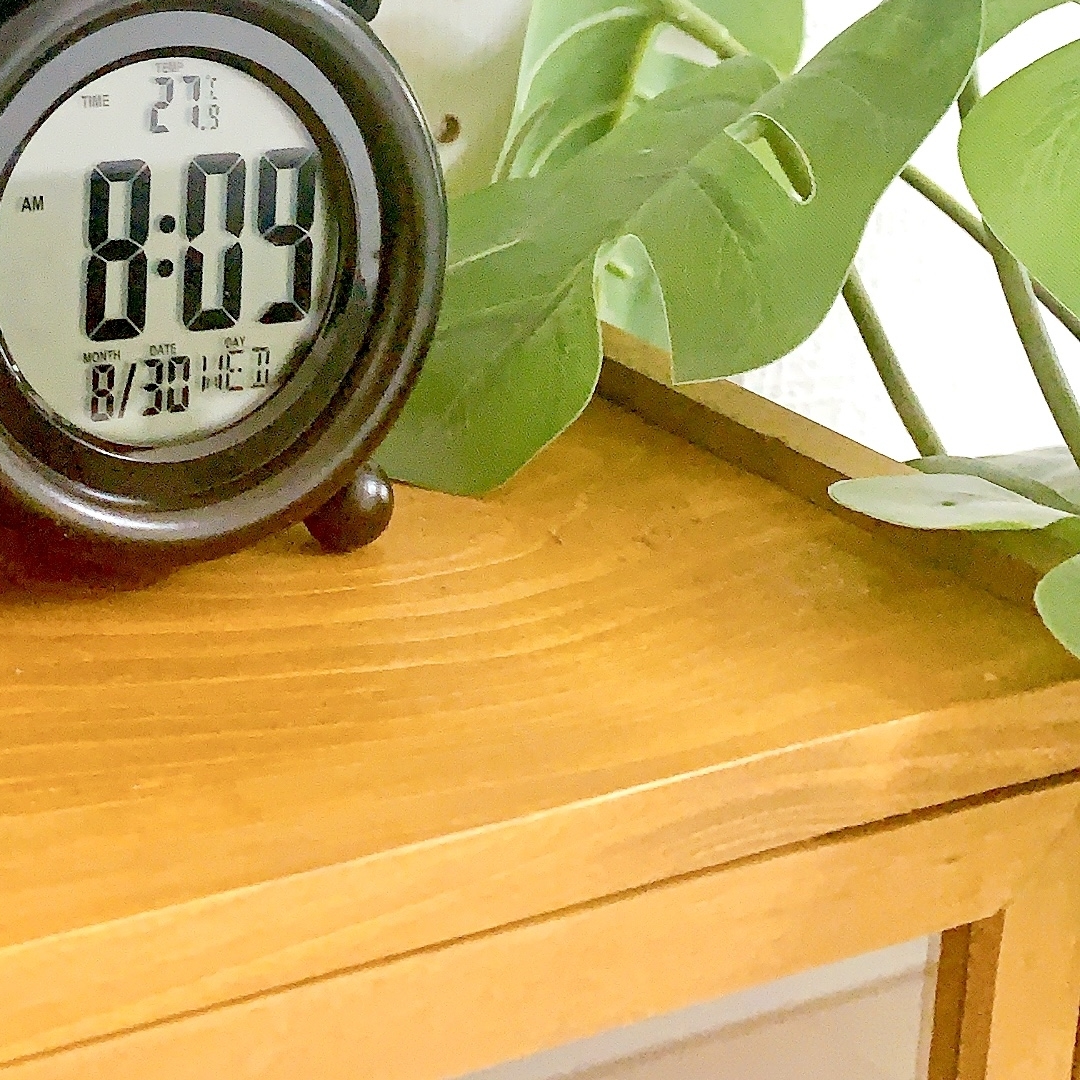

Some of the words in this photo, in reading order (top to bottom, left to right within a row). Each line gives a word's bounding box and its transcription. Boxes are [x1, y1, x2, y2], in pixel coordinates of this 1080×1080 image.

[154, 61, 184, 73] TEMP
[81, 94, 110, 108] TIME
[20, 195, 44, 212] AM
[85, 147, 317, 341] 8:09
[83, 350, 120, 363] MONTH
[150, 343, 177, 356] DATE
[224, 336, 246, 348] DAY
[90, 356, 190, 422] 8/30
[201, 347, 270, 392] WED
